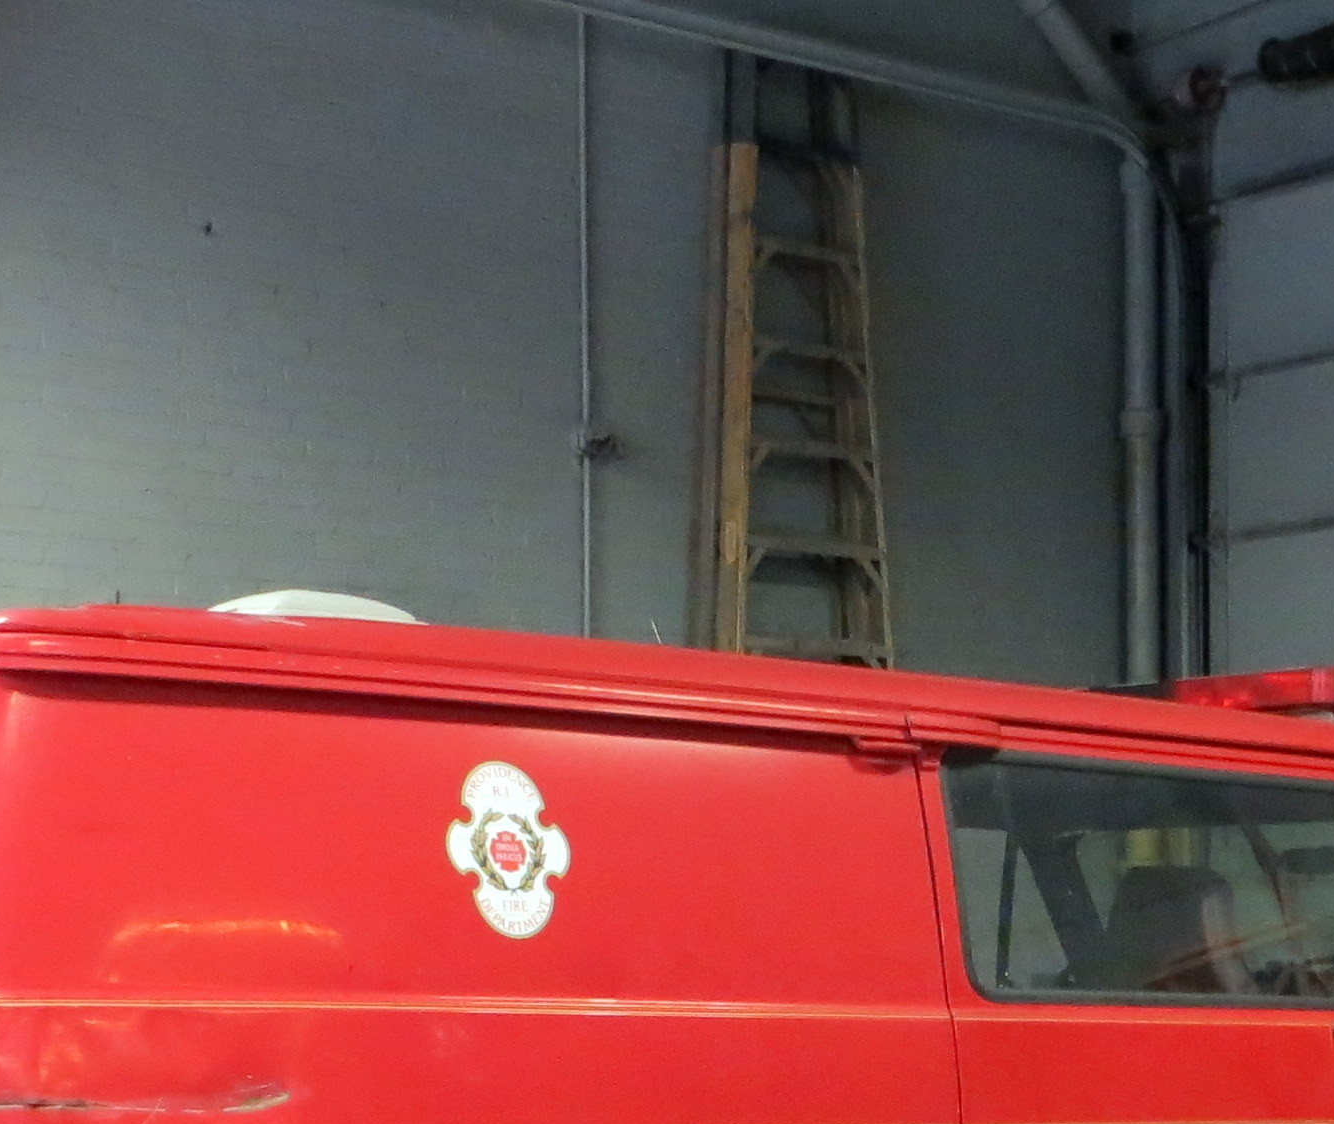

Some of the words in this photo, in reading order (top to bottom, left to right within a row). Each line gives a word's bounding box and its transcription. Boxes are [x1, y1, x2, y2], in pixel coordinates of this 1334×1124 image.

[467, 766, 540, 801] PROVIDENCE
[480, 898, 550, 933] DEPARTMENT
[502, 900, 528, 912] FIRE
